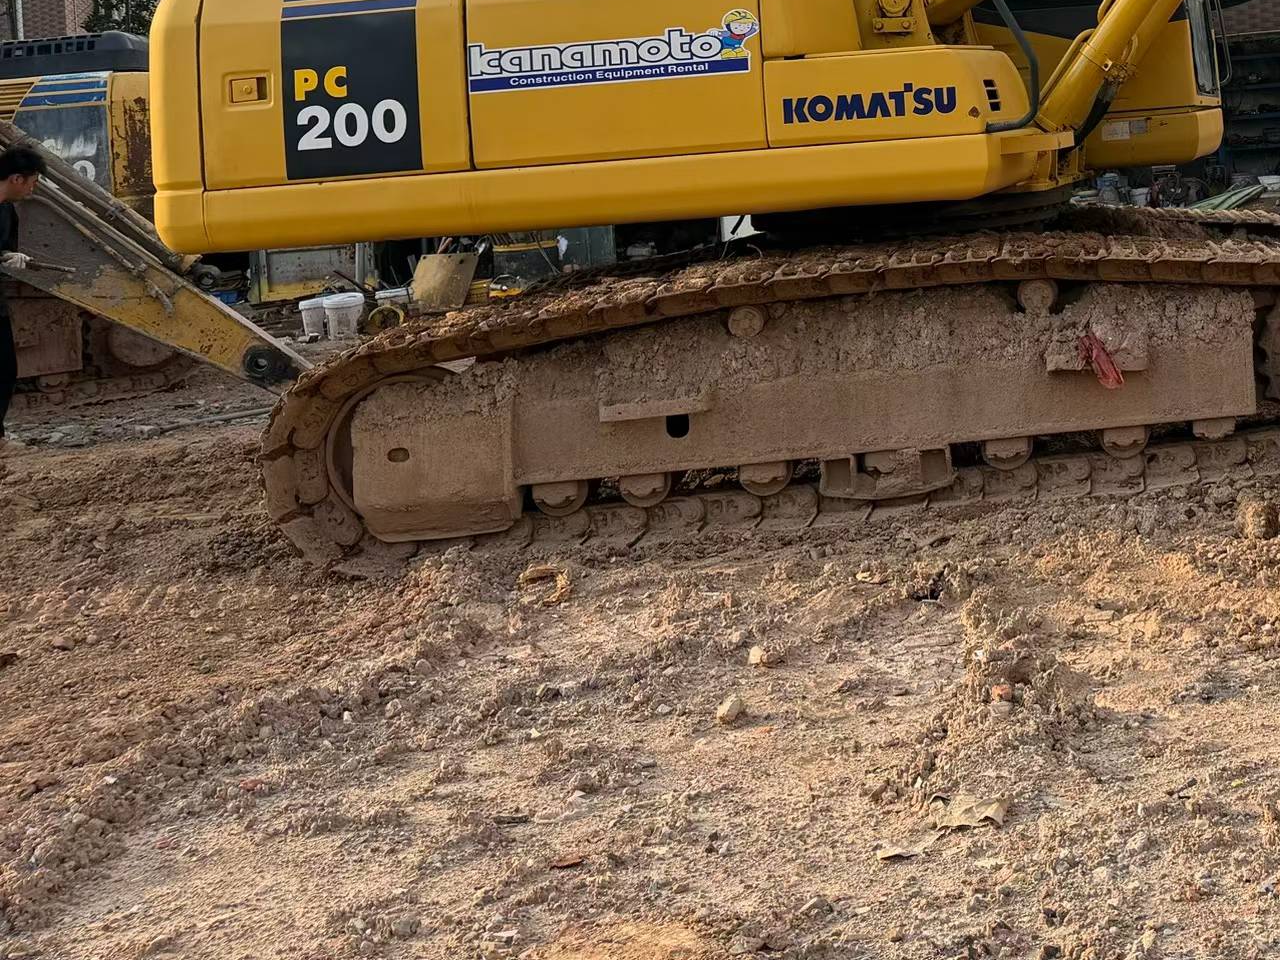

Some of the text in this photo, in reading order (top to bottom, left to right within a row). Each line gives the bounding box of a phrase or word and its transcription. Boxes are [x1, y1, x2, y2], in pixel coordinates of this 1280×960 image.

[469, 28, 723, 77] kanamoto
[294, 65, 348, 102] PC
[509, 62, 709, 87] Construction Equipment Rental
[782, 82, 957, 124] KOMATSU
[296, 98, 407, 151] 200
